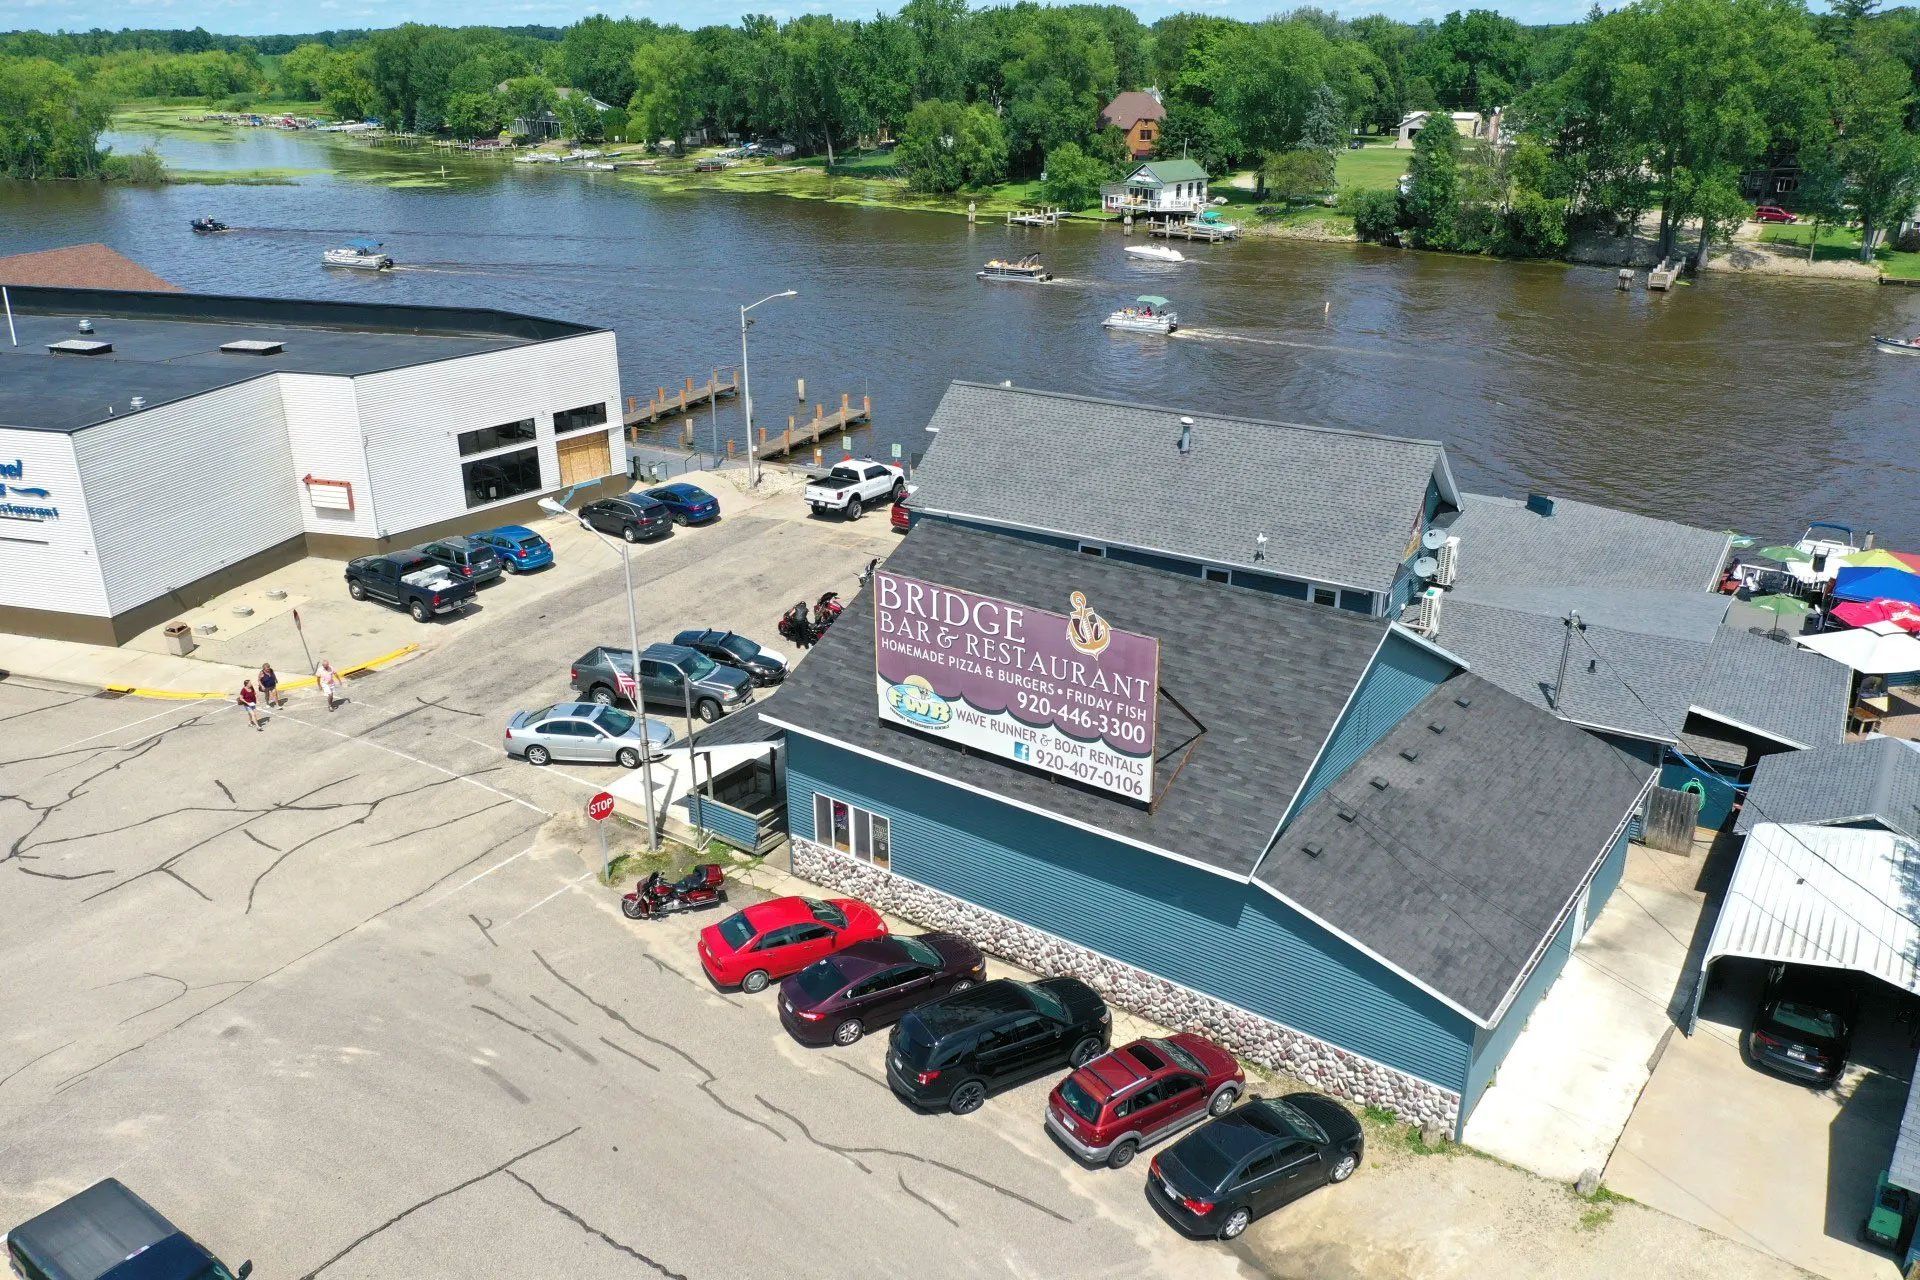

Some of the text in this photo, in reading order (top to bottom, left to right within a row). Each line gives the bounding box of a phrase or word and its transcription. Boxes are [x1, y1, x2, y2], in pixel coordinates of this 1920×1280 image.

[879, 575, 1025, 644] BRIDGE
[880, 610, 1150, 703] BAR & RESTAURANT
[881, 637, 1147, 722] HOMEMADE PIZZA & BURGERS FRIDAY FISH
[888, 687, 951, 723] FWR
[1017, 691, 1146, 744] 920-446-3300
[956, 708, 1144, 776] WAVE RUNNER & BOAT RENTALS
[1036, 749, 1143, 796] 920-407-0106
[590, 797, 612, 815] STOP
